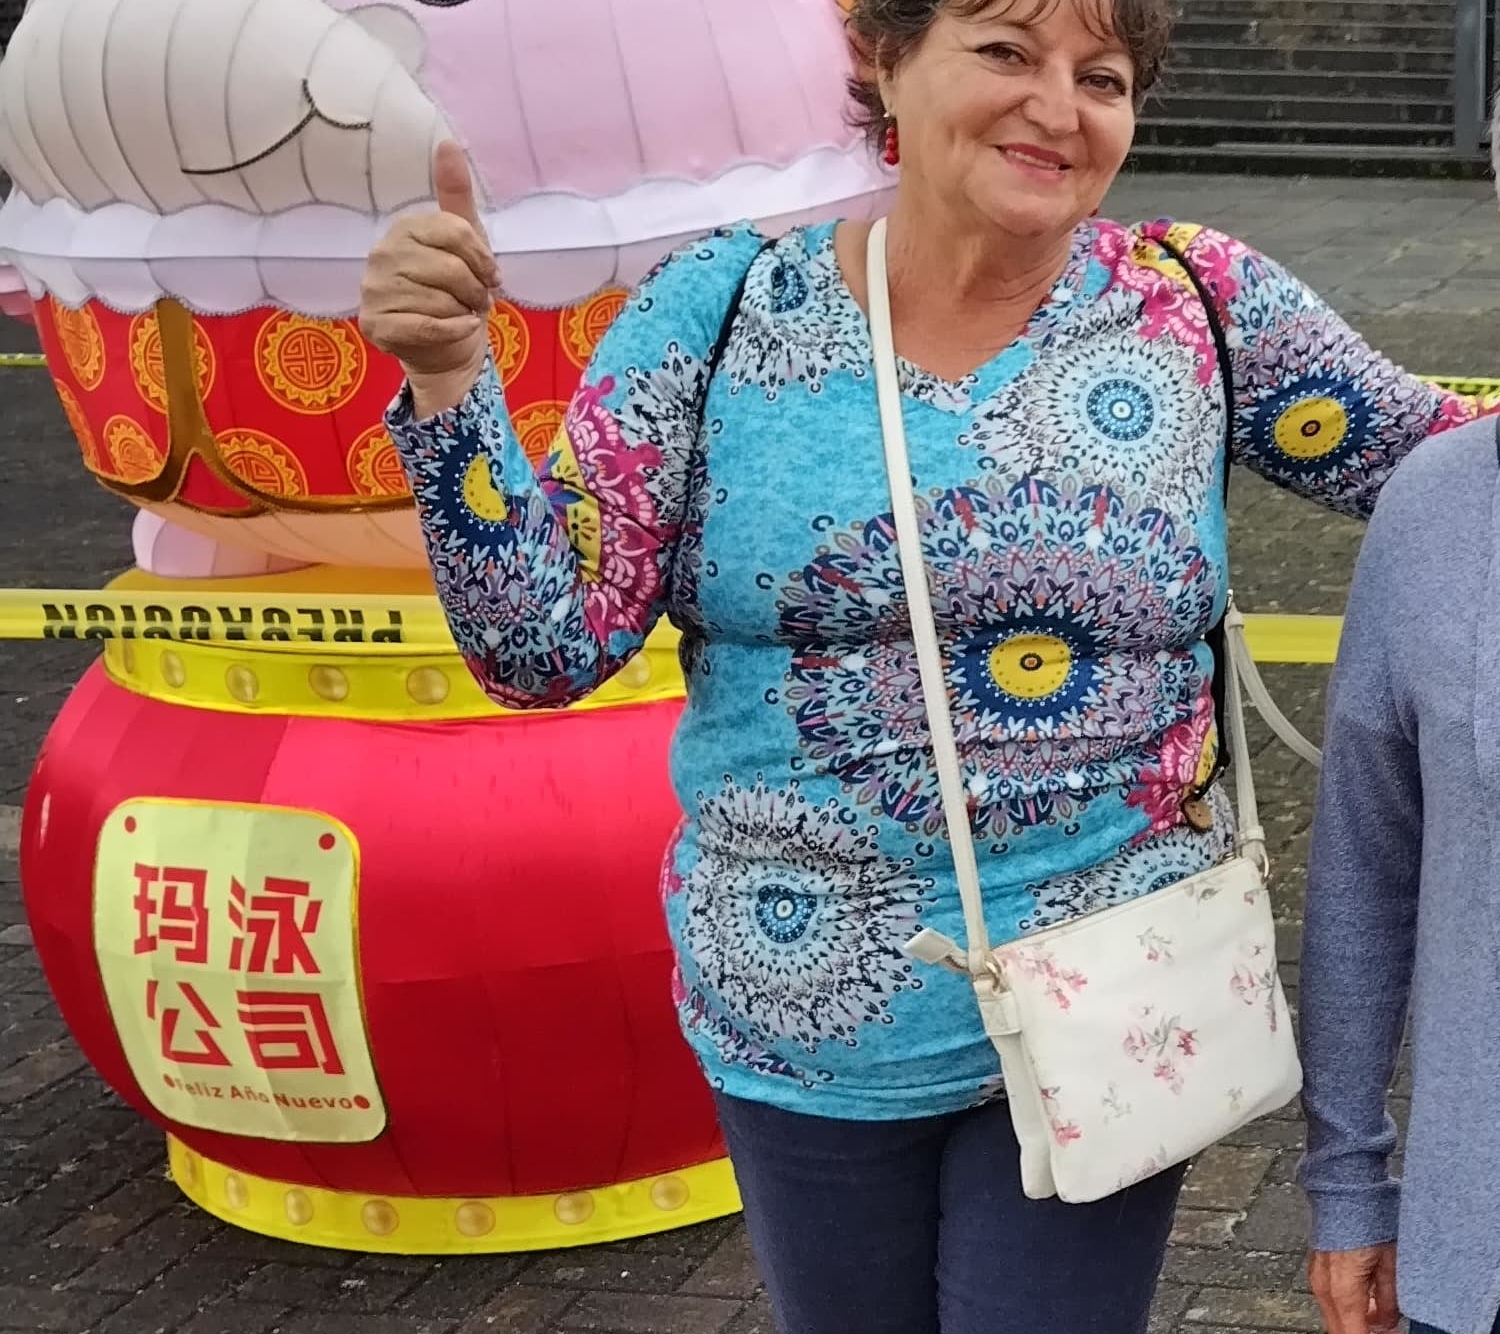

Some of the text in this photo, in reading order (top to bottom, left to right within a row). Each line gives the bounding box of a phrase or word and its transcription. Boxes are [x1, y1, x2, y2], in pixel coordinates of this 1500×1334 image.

[134, 863, 323, 974] 玛泳
[146, 980, 345, 1075] 公司
[174, 1078, 353, 1110] Feliz Año Nuevo
